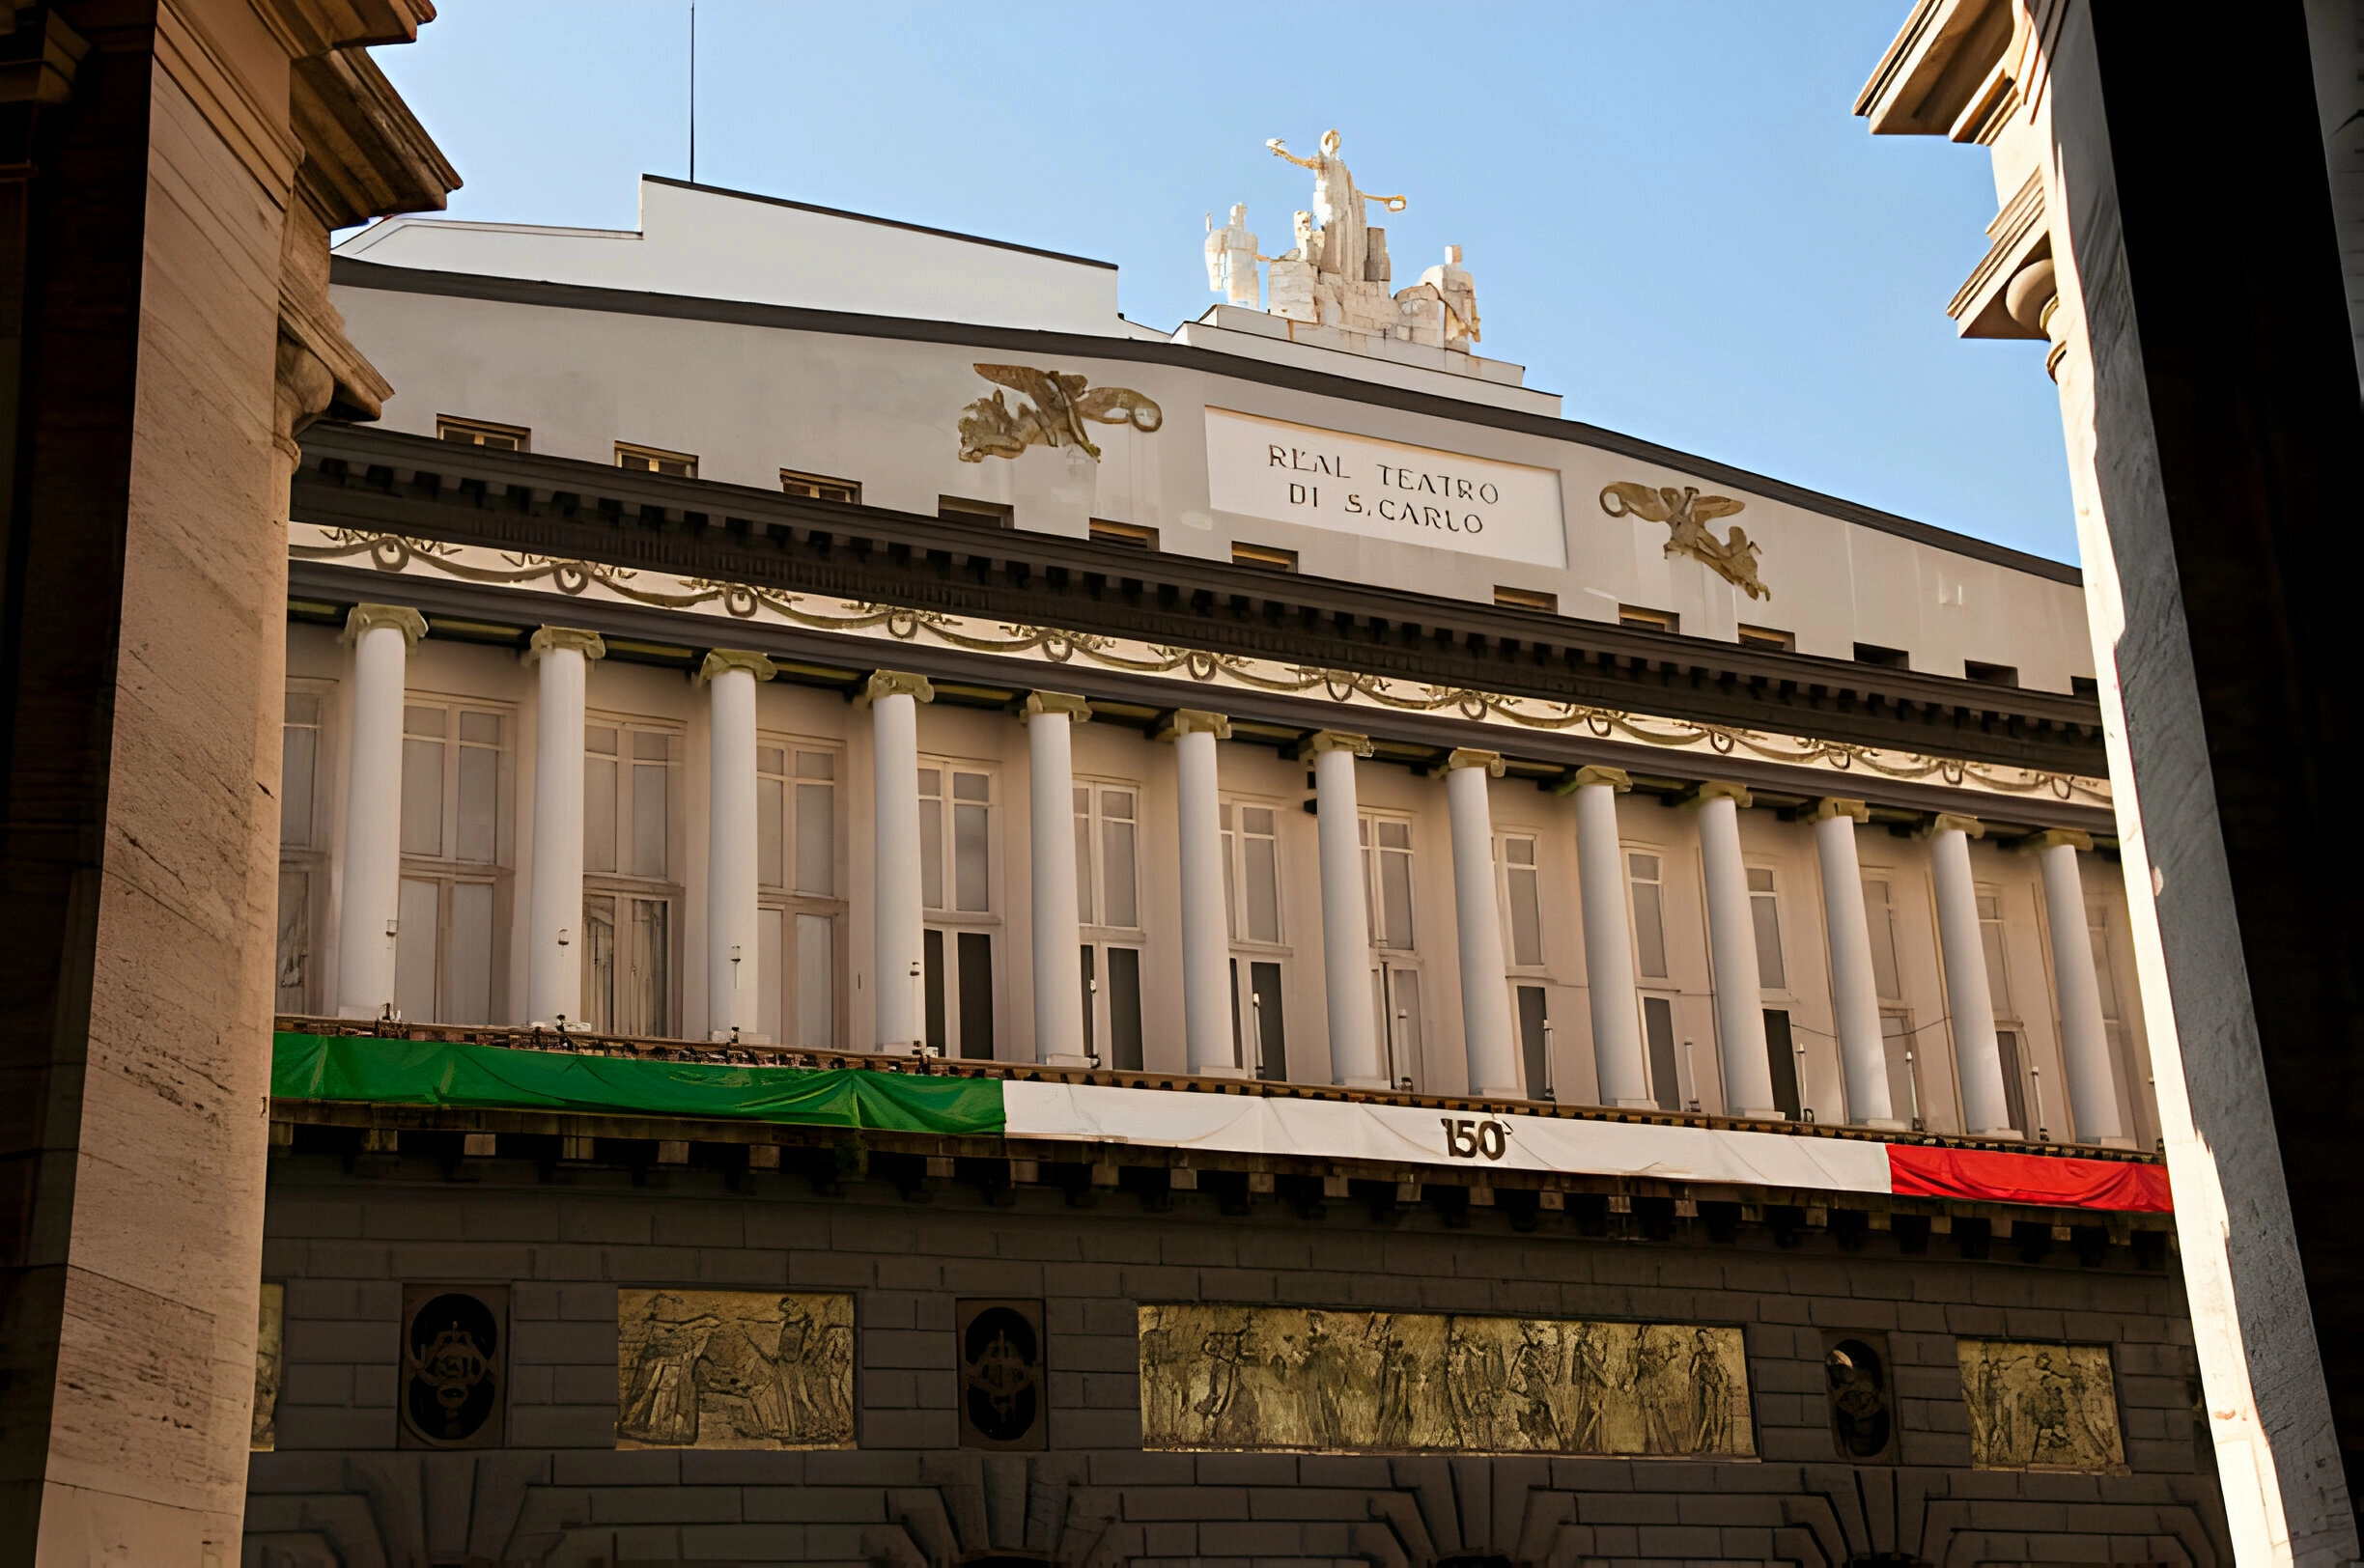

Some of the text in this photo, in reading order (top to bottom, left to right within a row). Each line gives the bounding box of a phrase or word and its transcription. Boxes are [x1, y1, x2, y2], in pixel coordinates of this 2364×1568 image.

[1269, 444, 1498, 504] REAL TEATRO
[1289, 483, 1317, 508] DI
